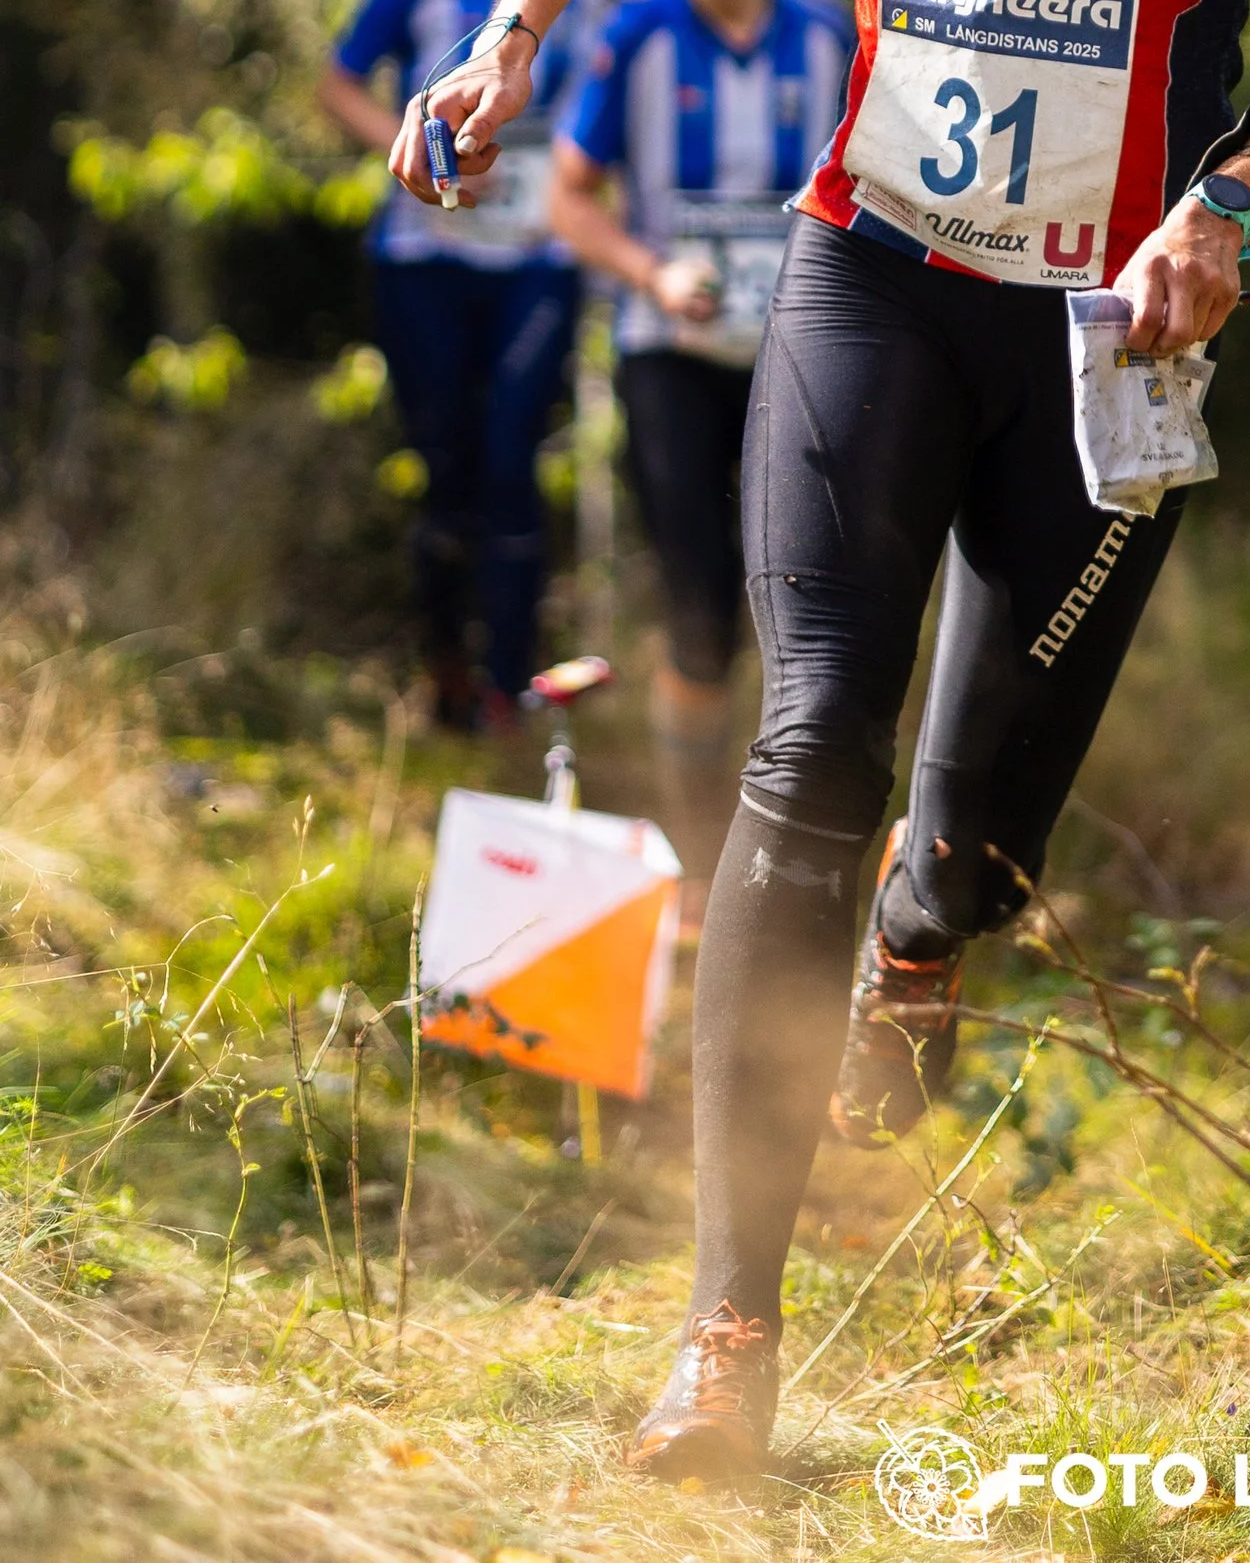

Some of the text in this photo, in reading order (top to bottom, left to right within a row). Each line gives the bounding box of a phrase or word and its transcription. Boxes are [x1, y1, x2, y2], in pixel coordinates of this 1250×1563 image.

[915, 17, 935, 34] SM
[1062, 41, 1101, 59] 2025
[919, 77, 1039, 205] 31
[925, 212, 1029, 253] Ullmax
[1040, 268, 1090, 282] UMARA
[1029, 511, 1137, 668] nonam
